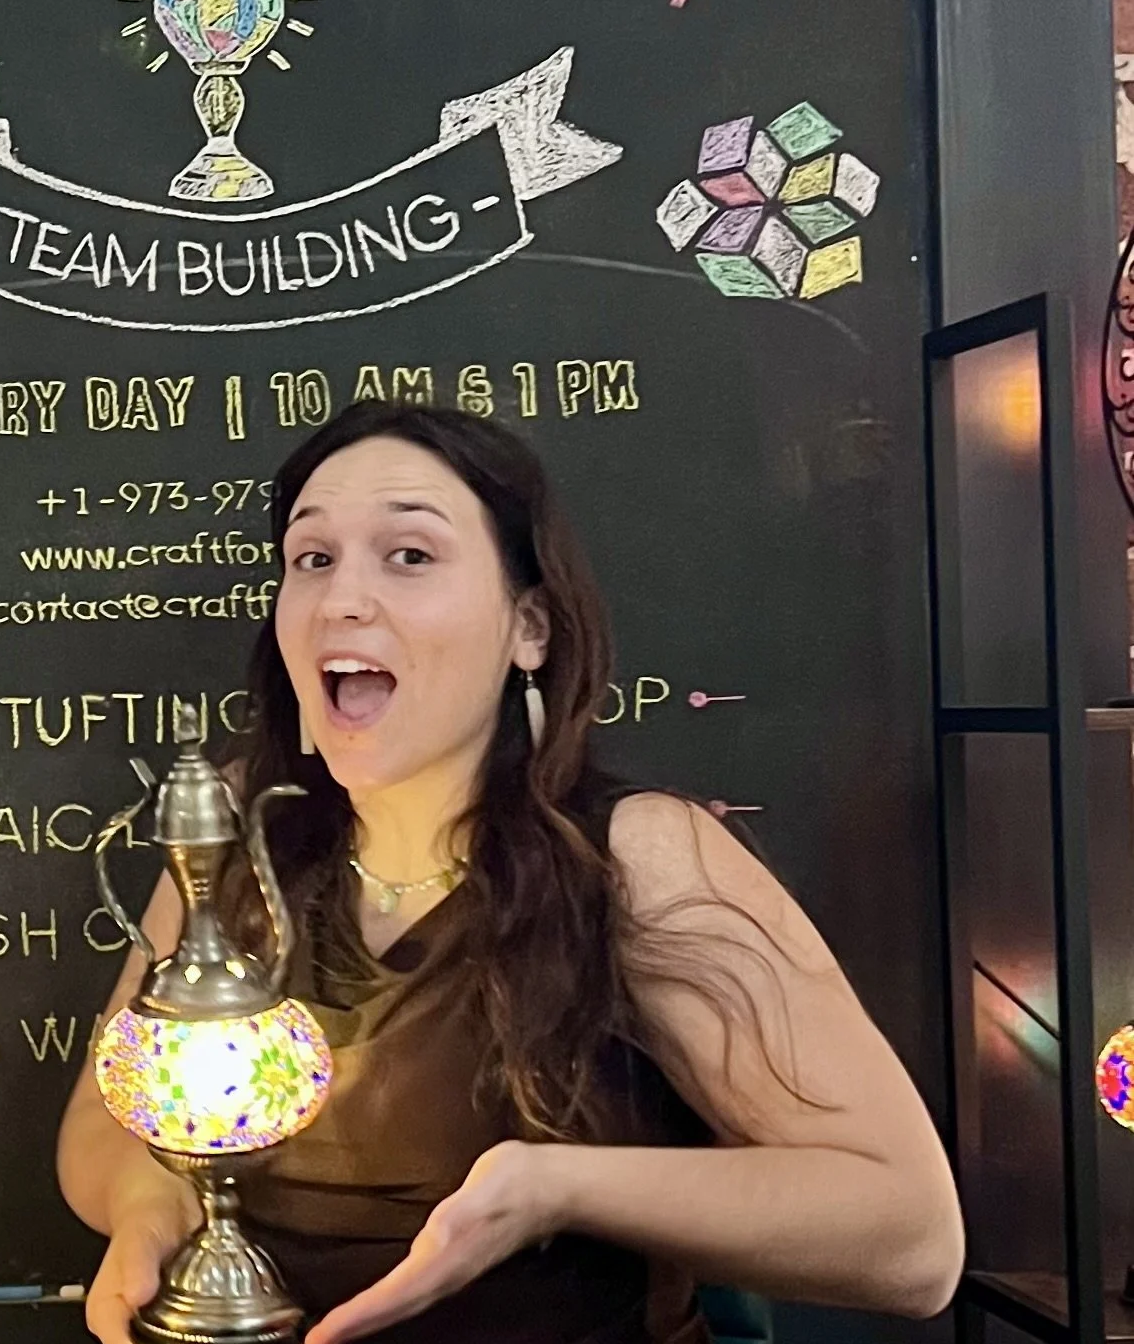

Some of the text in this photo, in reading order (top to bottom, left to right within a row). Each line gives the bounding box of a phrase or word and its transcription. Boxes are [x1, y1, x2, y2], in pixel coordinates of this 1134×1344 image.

[178, 193, 462, 297] BUILDING
[84, 375, 195, 432] DAY
[270, 368, 333, 427] 10
[353, 365, 436, 408] AM
[511, 362, 538, 418] 1
[556, 359, 640, 417] PM
